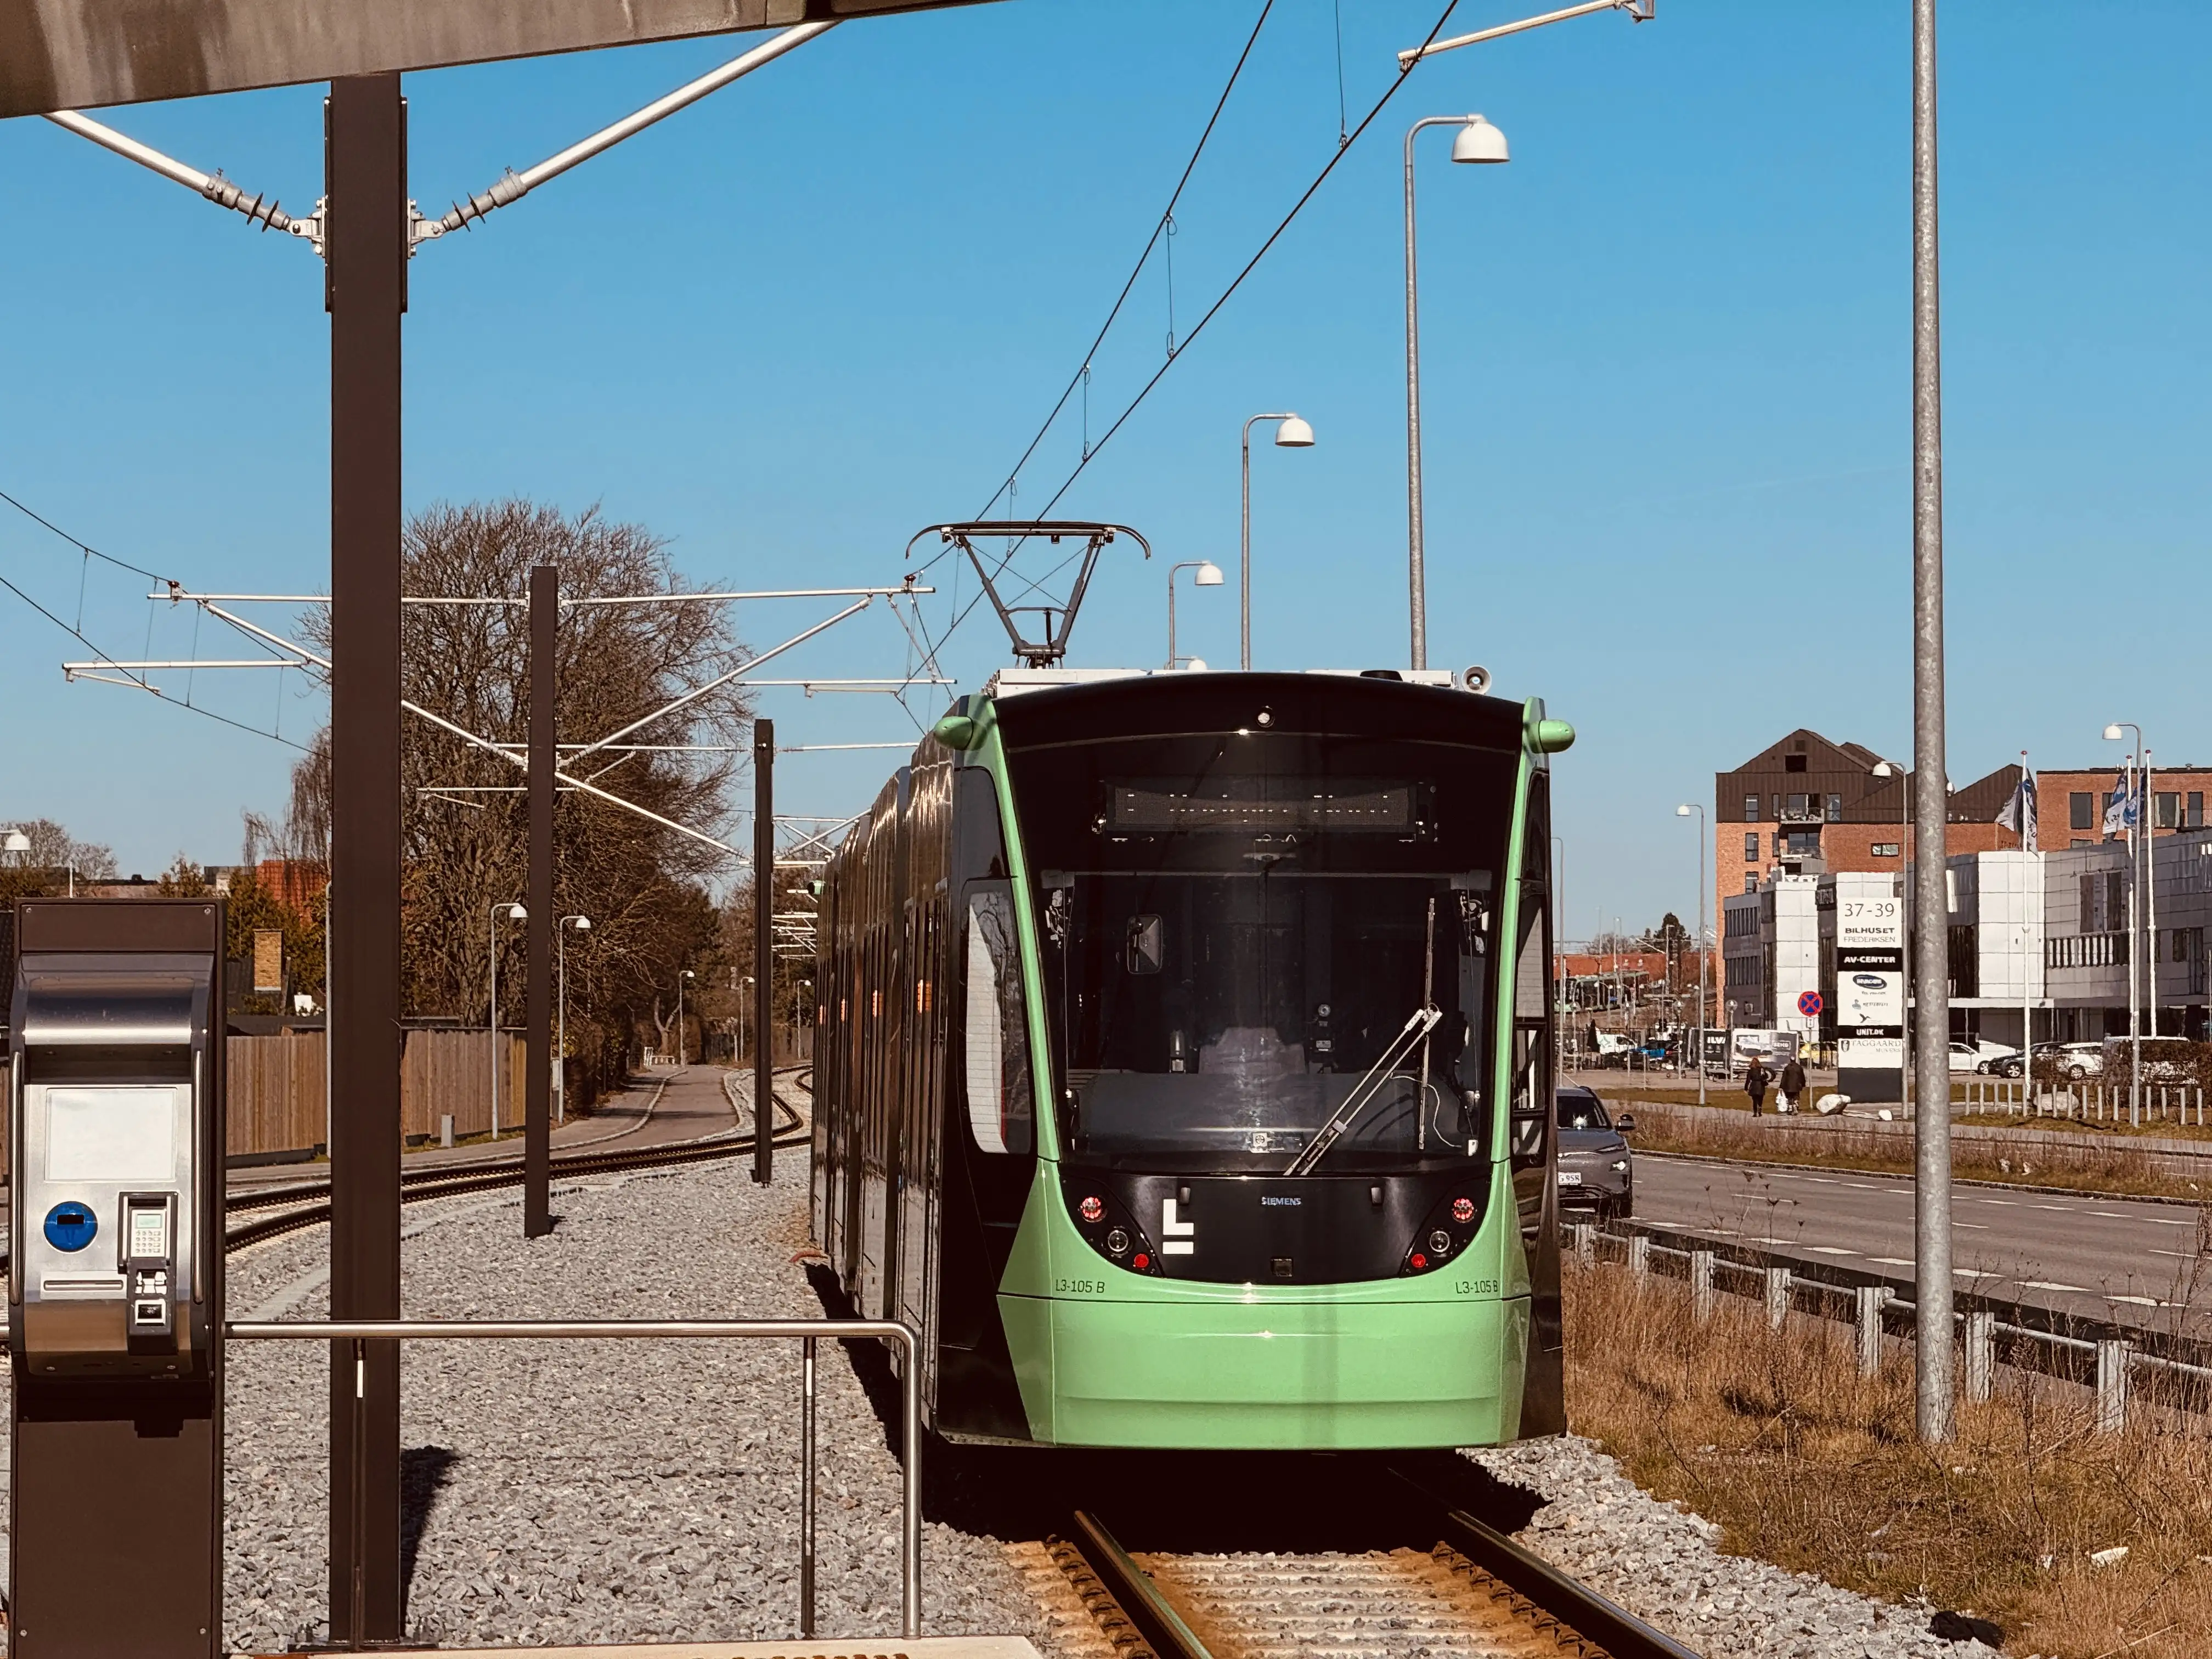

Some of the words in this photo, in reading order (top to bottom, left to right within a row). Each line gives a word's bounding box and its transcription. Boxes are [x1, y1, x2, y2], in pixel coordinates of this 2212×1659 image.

[1261, 1197, 1301, 1206] SIEMENS
[1056, 1279, 1093, 1293] L3-105
[1096, 1281, 1105, 1294] B
[1455, 1280, 1492, 1294] L3-105
[1493, 1280, 1498, 1293] B
